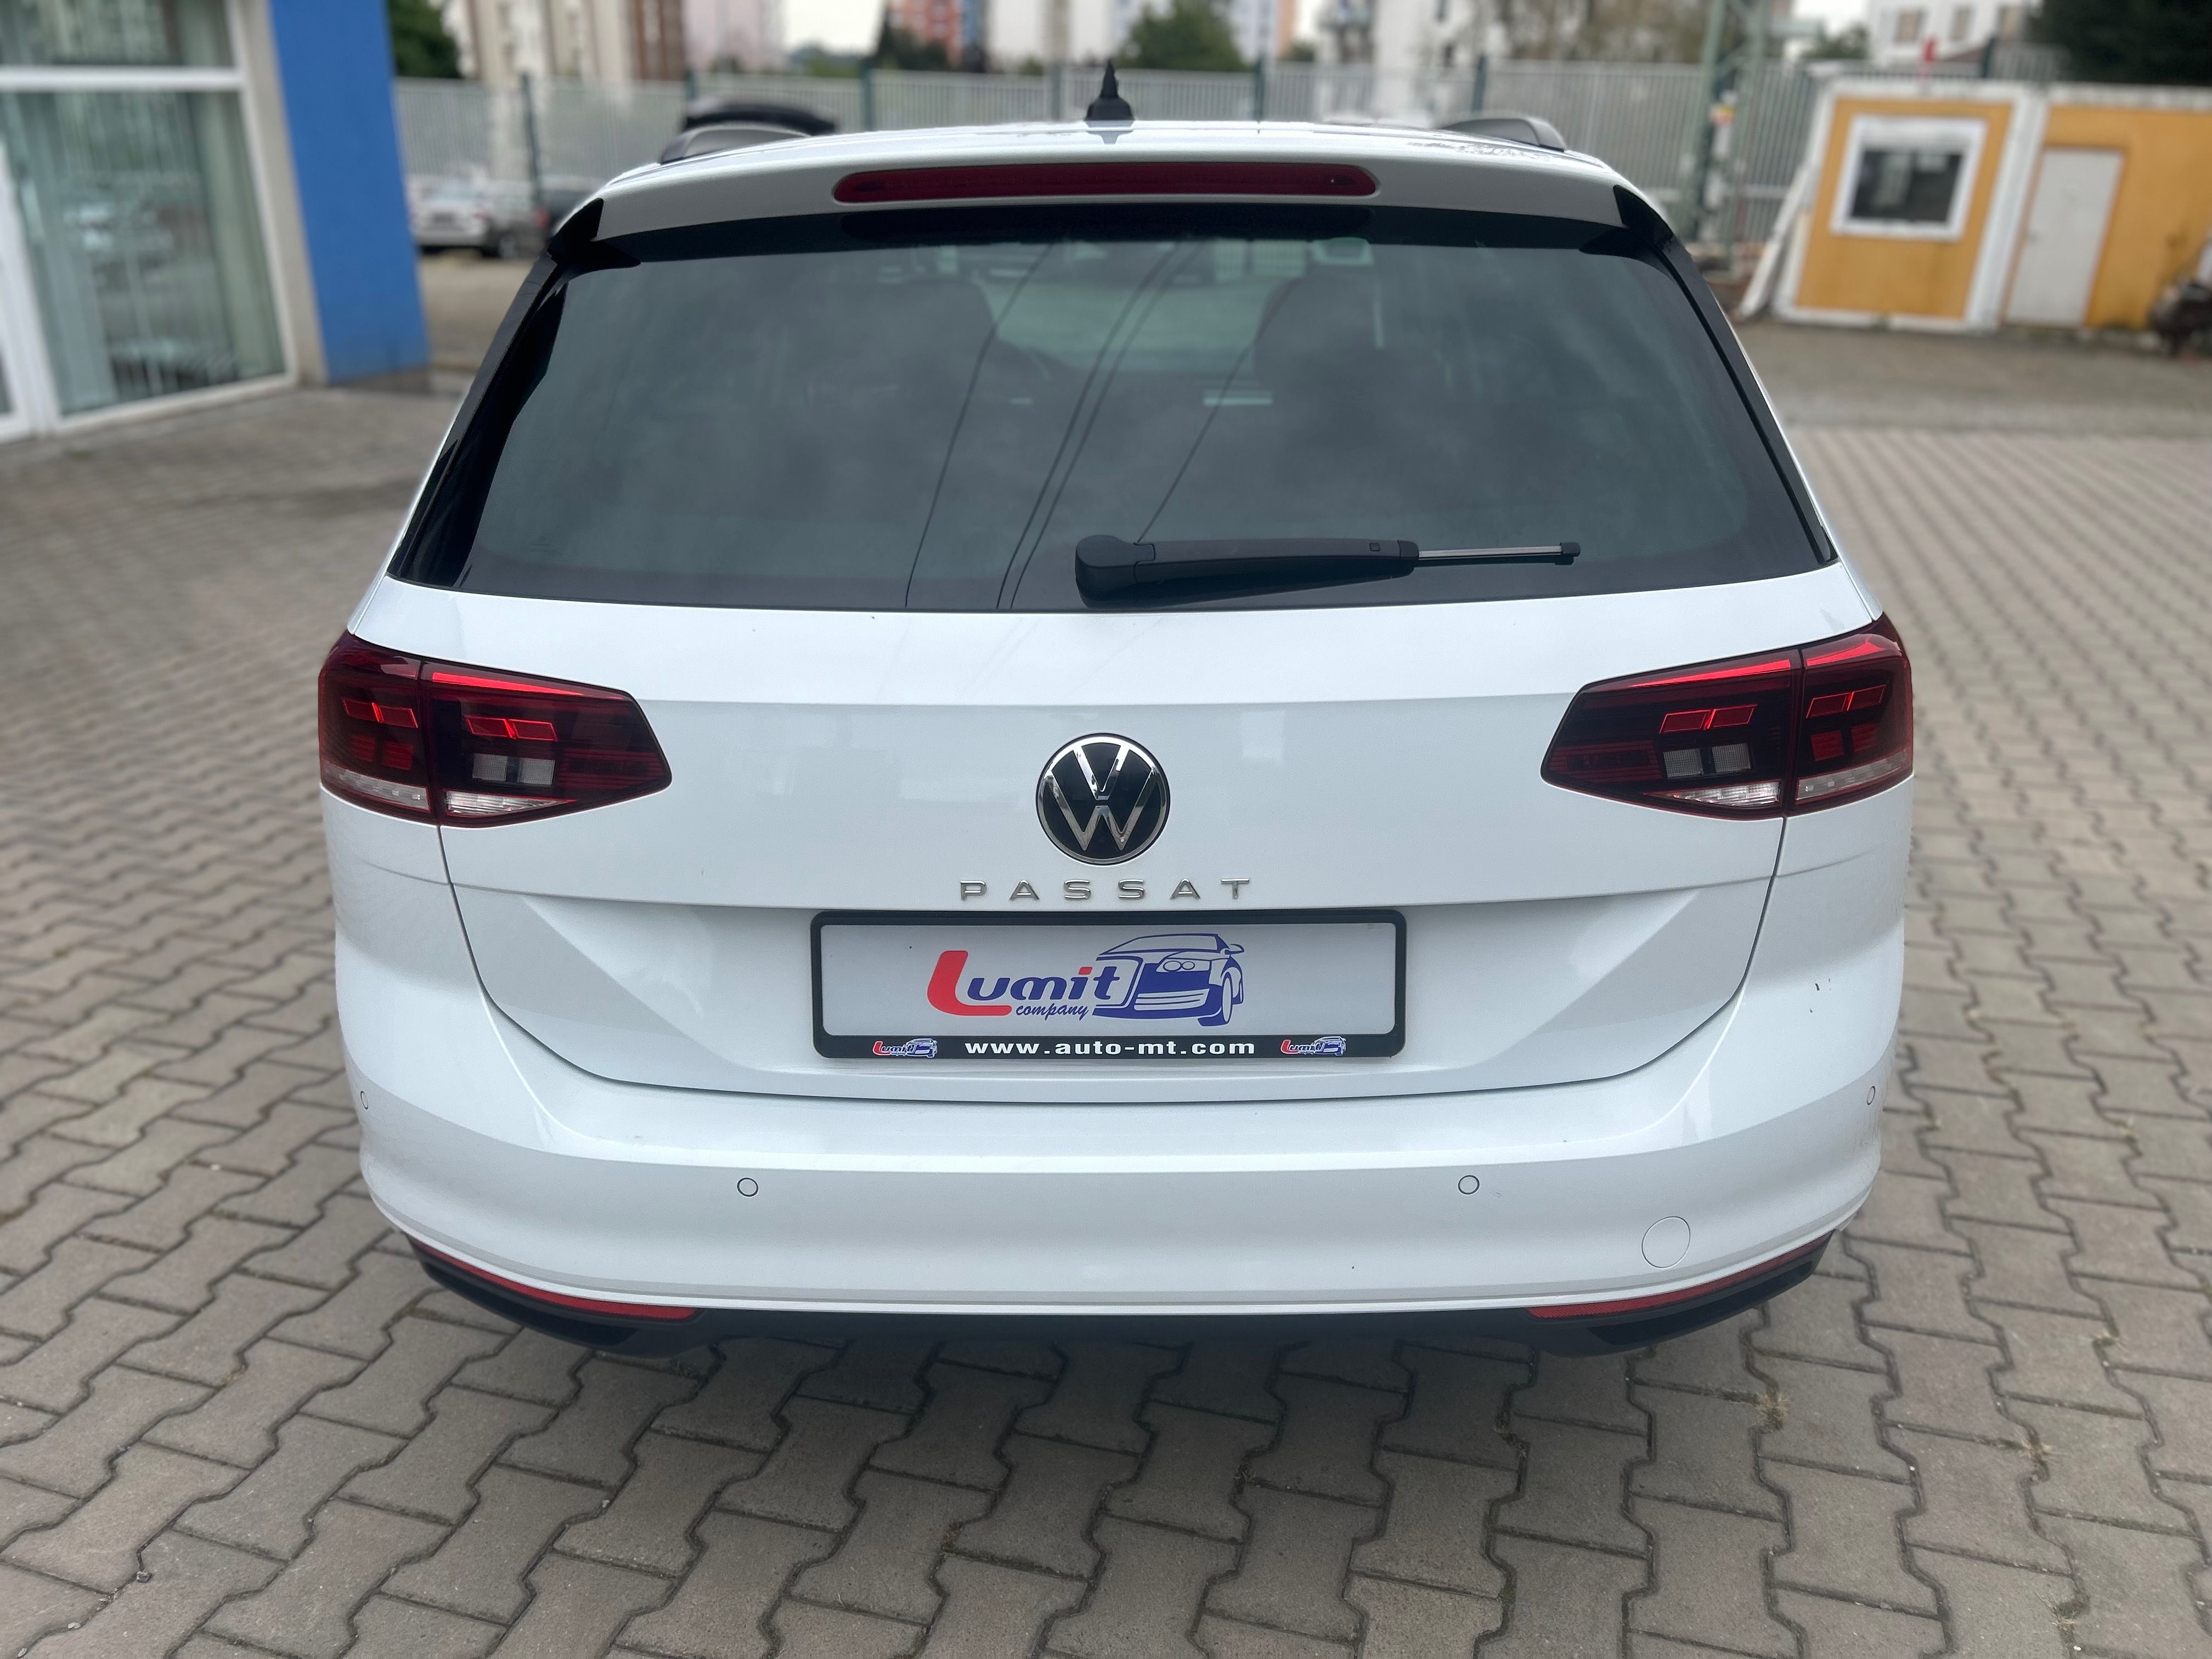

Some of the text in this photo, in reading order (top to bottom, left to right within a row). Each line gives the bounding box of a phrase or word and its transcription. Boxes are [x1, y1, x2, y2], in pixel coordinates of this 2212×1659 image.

[960, 878, 1250, 901] PASSAT
[928, 951, 1120, 1016] Lumit
[1015, 1002, 1089, 1021] company
[873, 1041, 912, 1056] Lumit
[964, 1041, 1255, 1054] www.auto-mt.com
